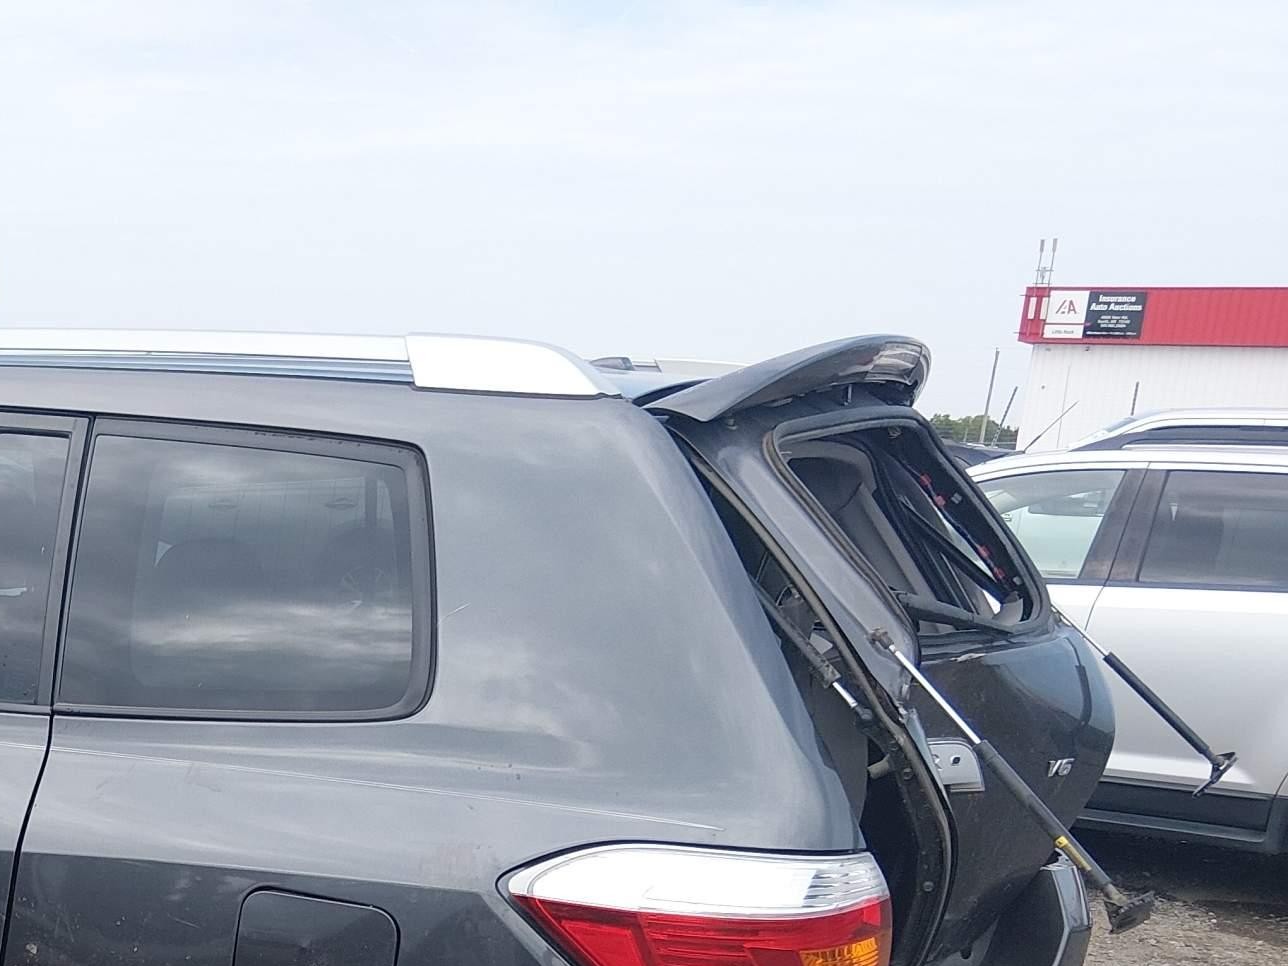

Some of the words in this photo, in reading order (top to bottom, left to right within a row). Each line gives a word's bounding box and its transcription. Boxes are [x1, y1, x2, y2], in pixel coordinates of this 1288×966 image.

[1099, 294, 1137, 302] Insurance
[1090, 303, 1108, 311] Auto
[1108, 302, 1143, 311] Auctions
[1048, 758, 1074, 777] V6
